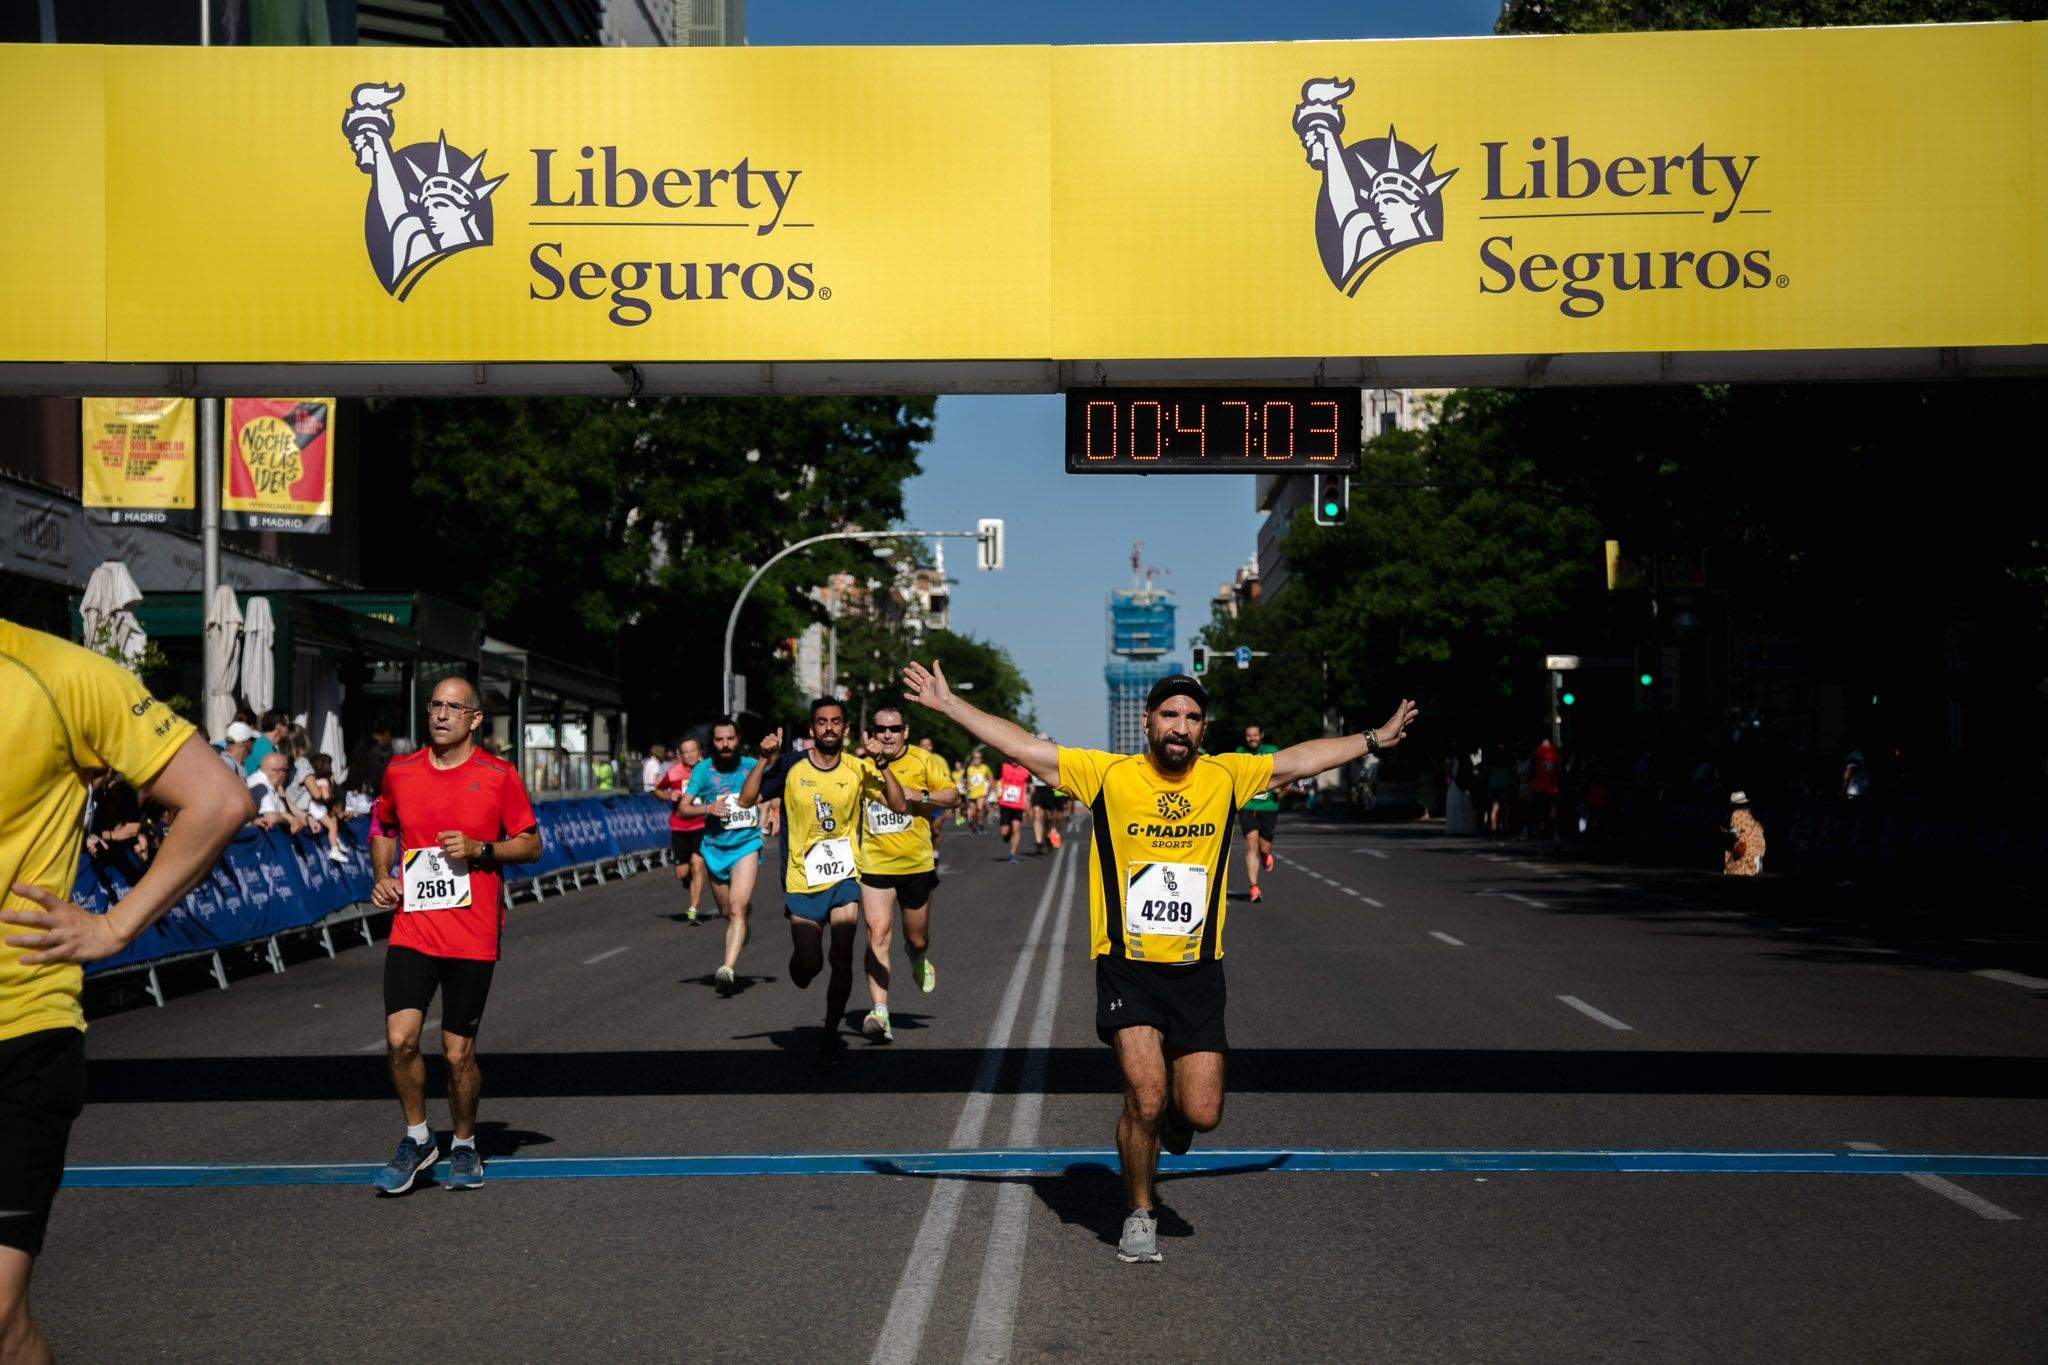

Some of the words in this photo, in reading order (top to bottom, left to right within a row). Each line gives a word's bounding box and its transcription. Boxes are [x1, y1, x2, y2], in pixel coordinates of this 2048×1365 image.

[530, 145, 802, 236] Liberty
[1480, 136, 1760, 223] Liberty
[257, 419, 275, 433] LA
[1087, 400, 1339, 461] 00:47:03
[242, 427, 293, 451] NOCHE
[250, 451, 266, 466] DE
[269, 451, 298, 470] LAS
[254, 467, 299, 494] IDEAS
[124, 512, 166, 523] MADRID
[262, 516, 303, 528] MADRID
[417, 878, 456, 900] 2581
[1141, 900, 1193, 922] 4289
